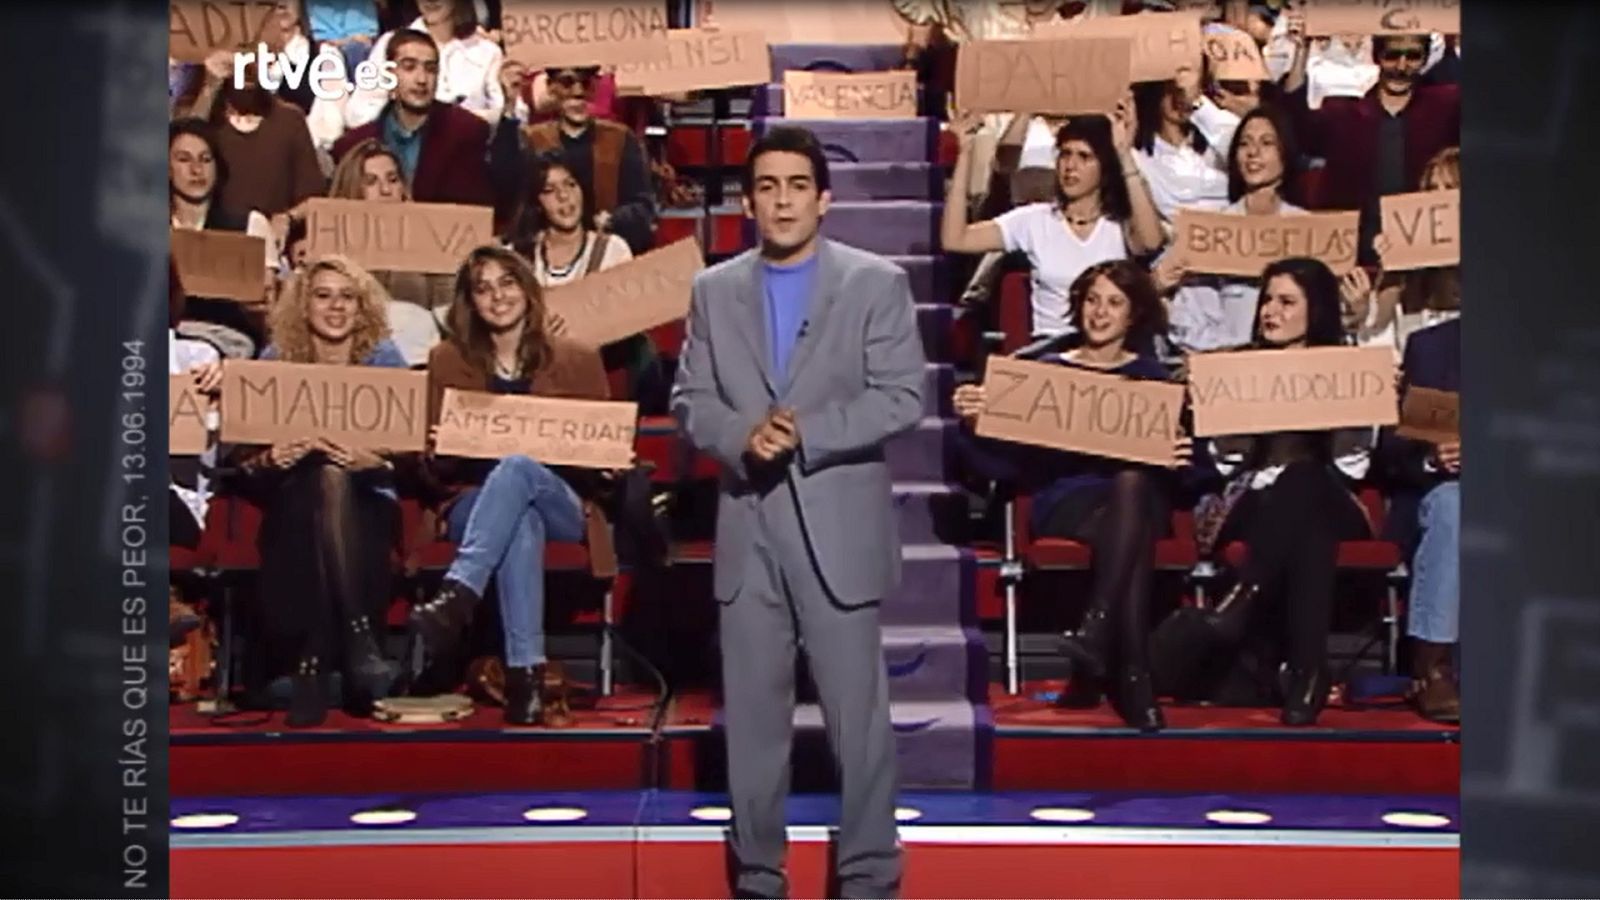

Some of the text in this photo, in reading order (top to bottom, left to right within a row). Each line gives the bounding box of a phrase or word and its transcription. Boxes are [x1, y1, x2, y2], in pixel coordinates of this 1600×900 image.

[502, 6, 667, 46] BARCELONA
[786, 82, 917, 111] VALENCIA
[1393, 203, 1452, 247] VE
[239, 374, 416, 436] MAHON
[983, 369, 1172, 441] ZAMORA
[1190, 369, 1386, 408] VALLADOLID
[443, 409, 635, 445] AMSTERDAM
